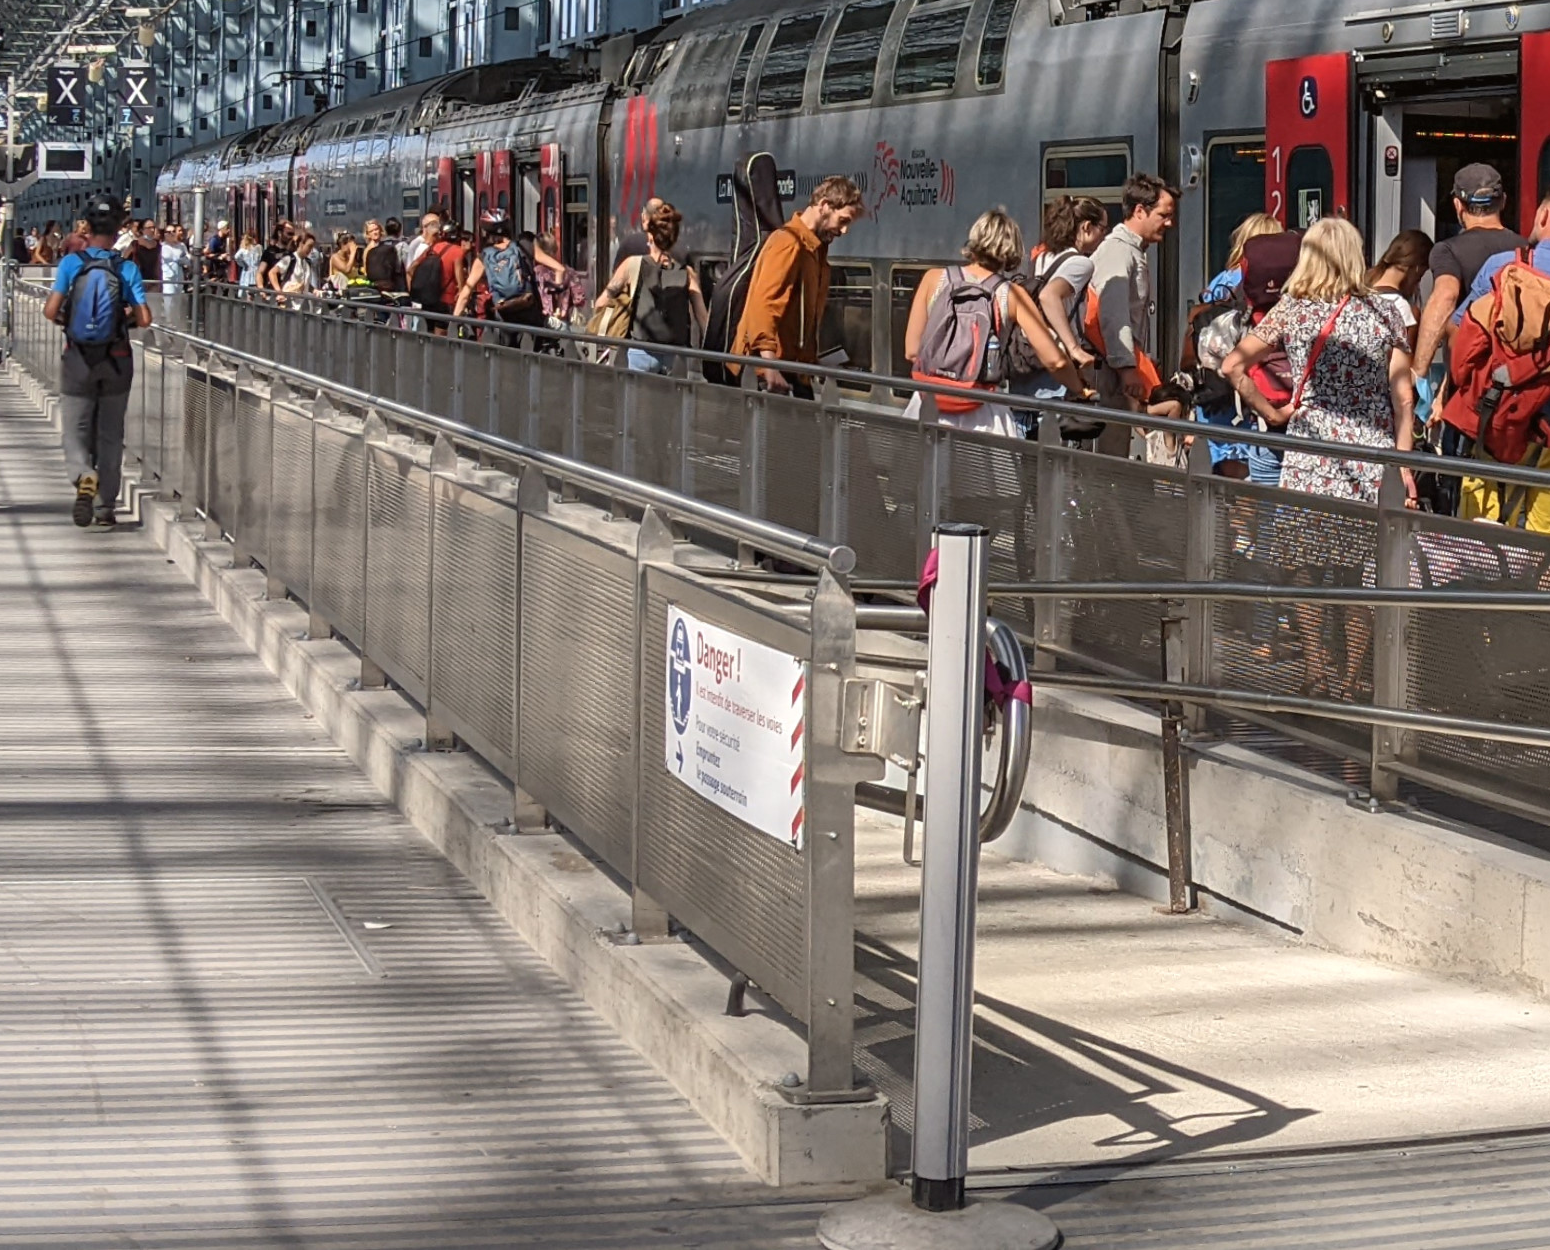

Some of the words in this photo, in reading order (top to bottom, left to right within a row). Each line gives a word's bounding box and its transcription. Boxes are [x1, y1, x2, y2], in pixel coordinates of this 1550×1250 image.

[55, 77, 79, 105] X
[126, 77, 149, 105] X
[900, 158, 939, 179] Nouvelle-
[1271, 146, 1281, 183] 1
[900, 182, 938, 213] Aquitaine
[697, 631, 735, 685] Danger
[737, 648, 741, 683] !
[724, 695, 732, 713] de
[732, 698, 756, 723] traverser
[757, 709, 765, 727] les
[766, 715, 783, 735] voies
